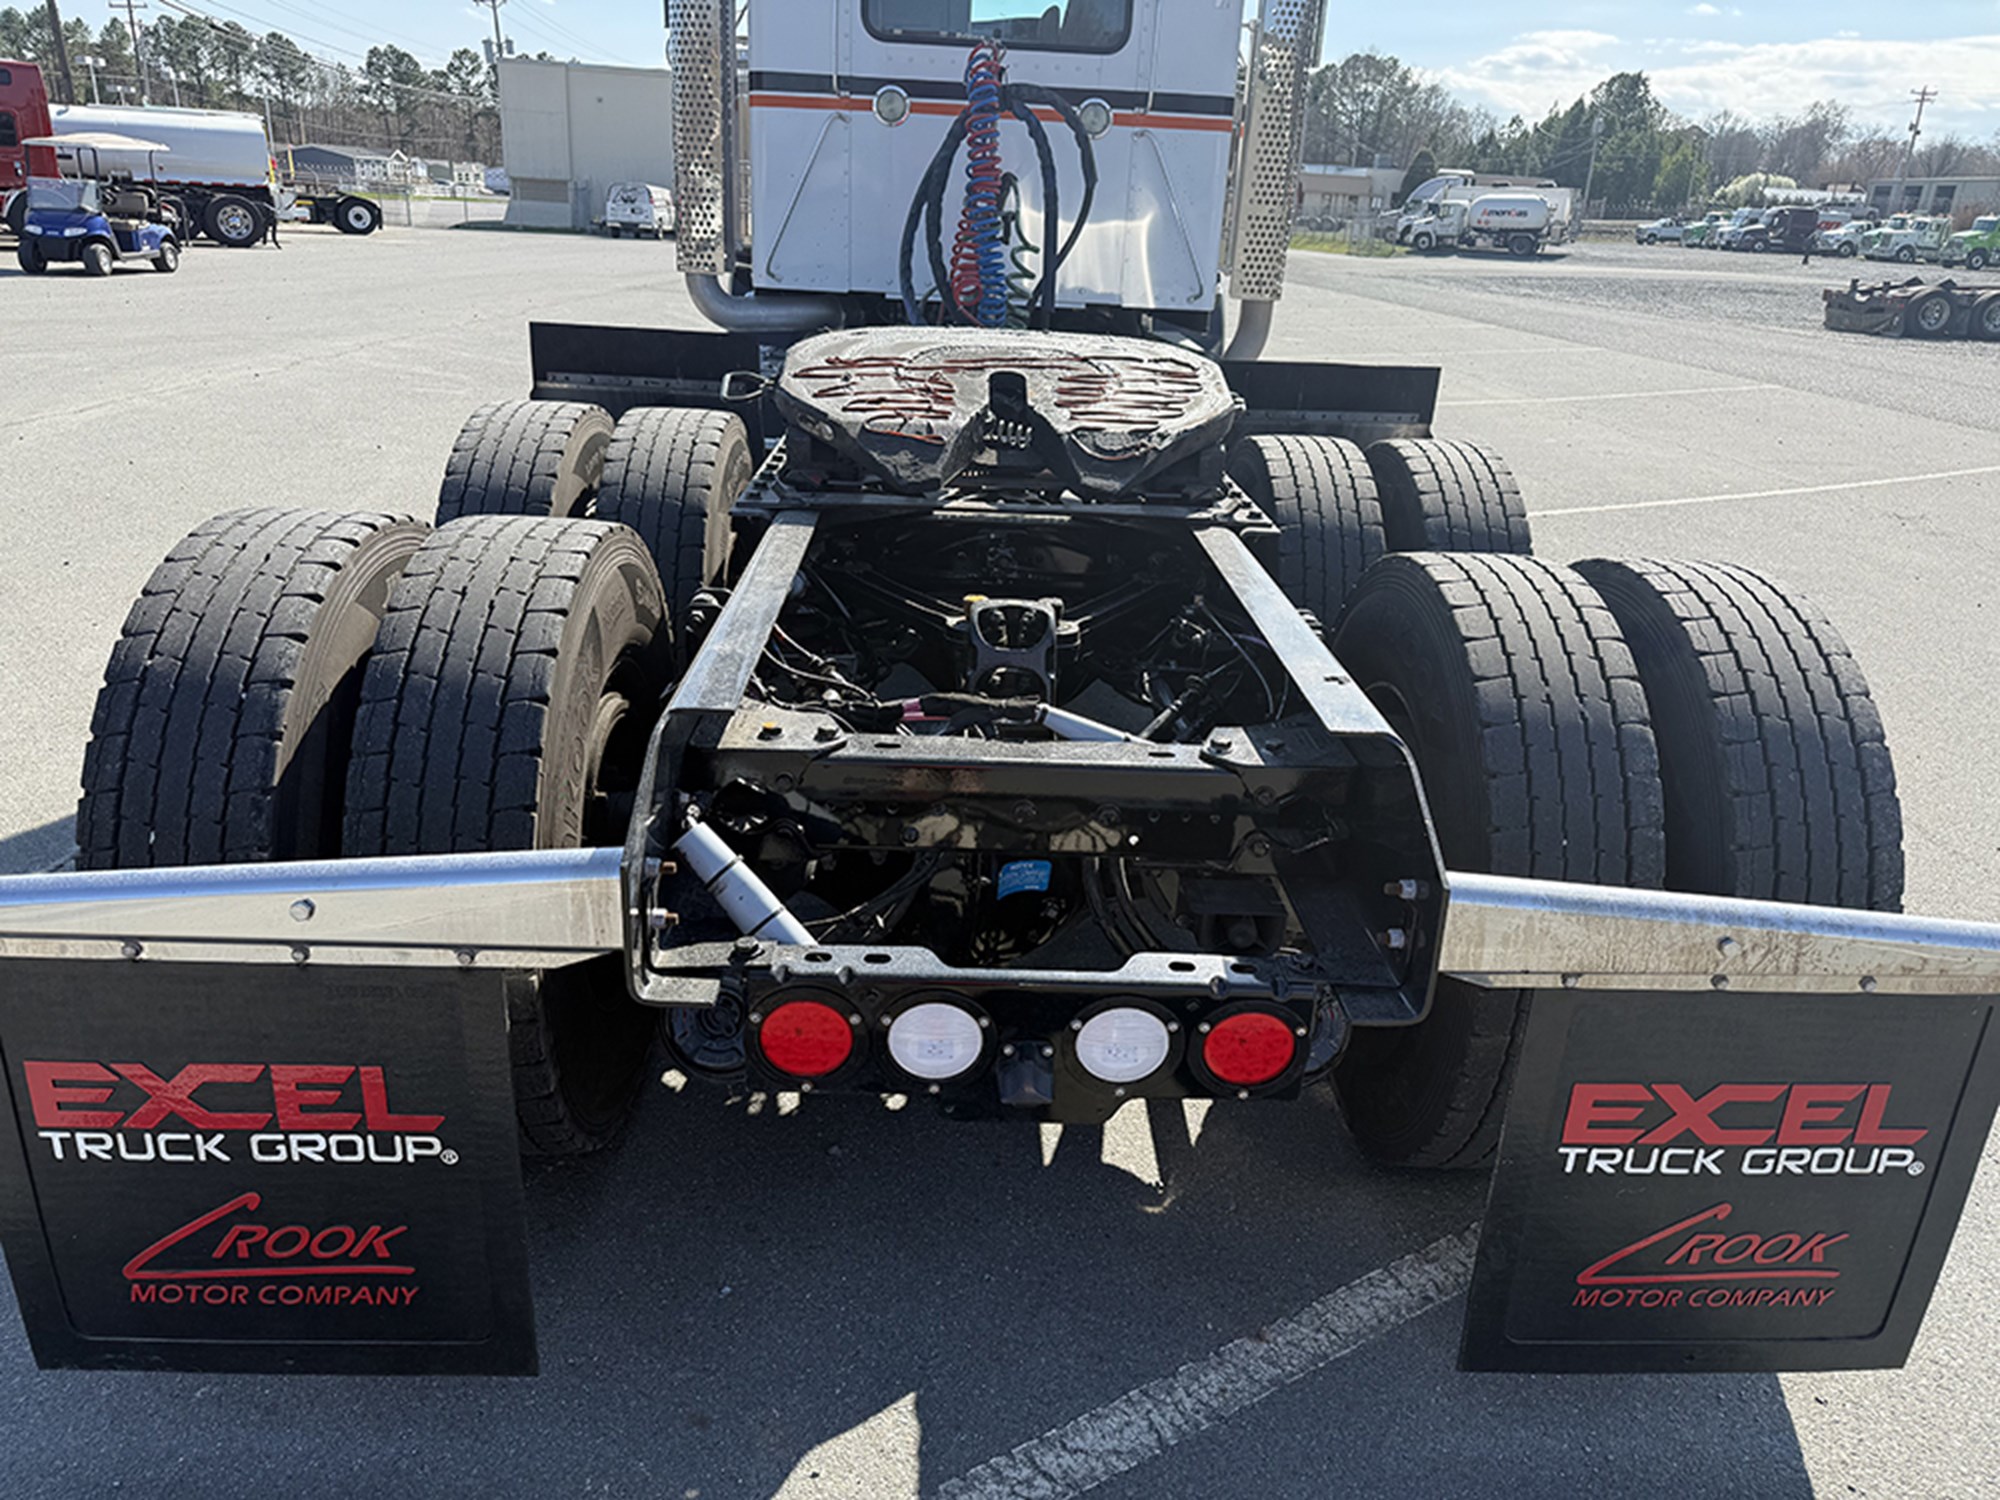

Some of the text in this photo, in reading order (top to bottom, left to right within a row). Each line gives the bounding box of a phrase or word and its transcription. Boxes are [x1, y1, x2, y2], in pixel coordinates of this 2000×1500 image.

[23, 1061, 445, 1131] EXCEL
[1562, 1083, 1928, 1145] EXCEL
[38, 1132, 231, 1162] TRUCK
[1558, 1147, 1724, 1175] TRUCK
[130, 1283, 419, 1306] MOTOR COMPANY
[1573, 1289, 1836, 1308] MOTOR COMPANY
